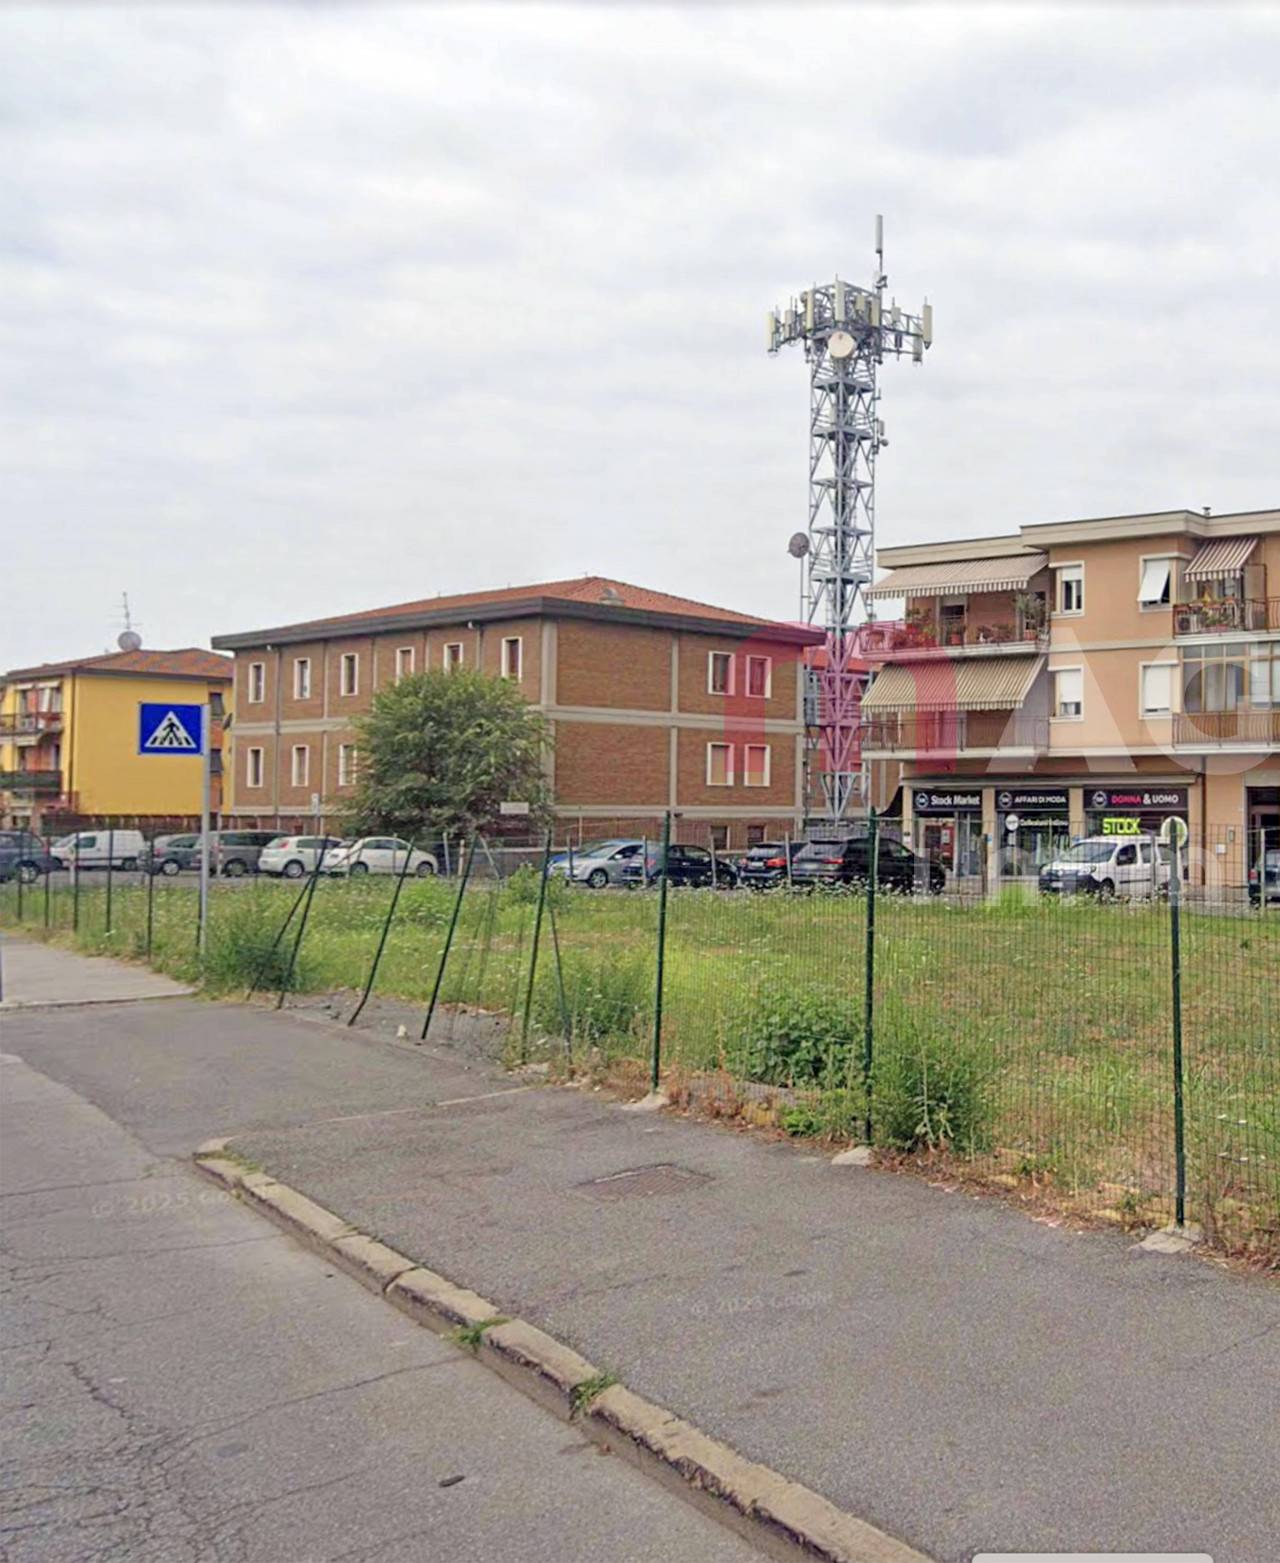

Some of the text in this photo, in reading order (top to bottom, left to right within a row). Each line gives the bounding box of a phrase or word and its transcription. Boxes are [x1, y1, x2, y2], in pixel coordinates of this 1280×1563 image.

[931, 795, 952, 806] Stock
[953, 795, 980, 806] Market
[1014, 795, 1038, 804] AFFARI
[1044, 795, 1067, 804] MODA
[1111, 795, 1141, 804] DONNA
[1143, 793, 1152, 805] &
[1152, 794, 1179, 804] UOMO
[1102, 817, 1141, 834] STOCK
